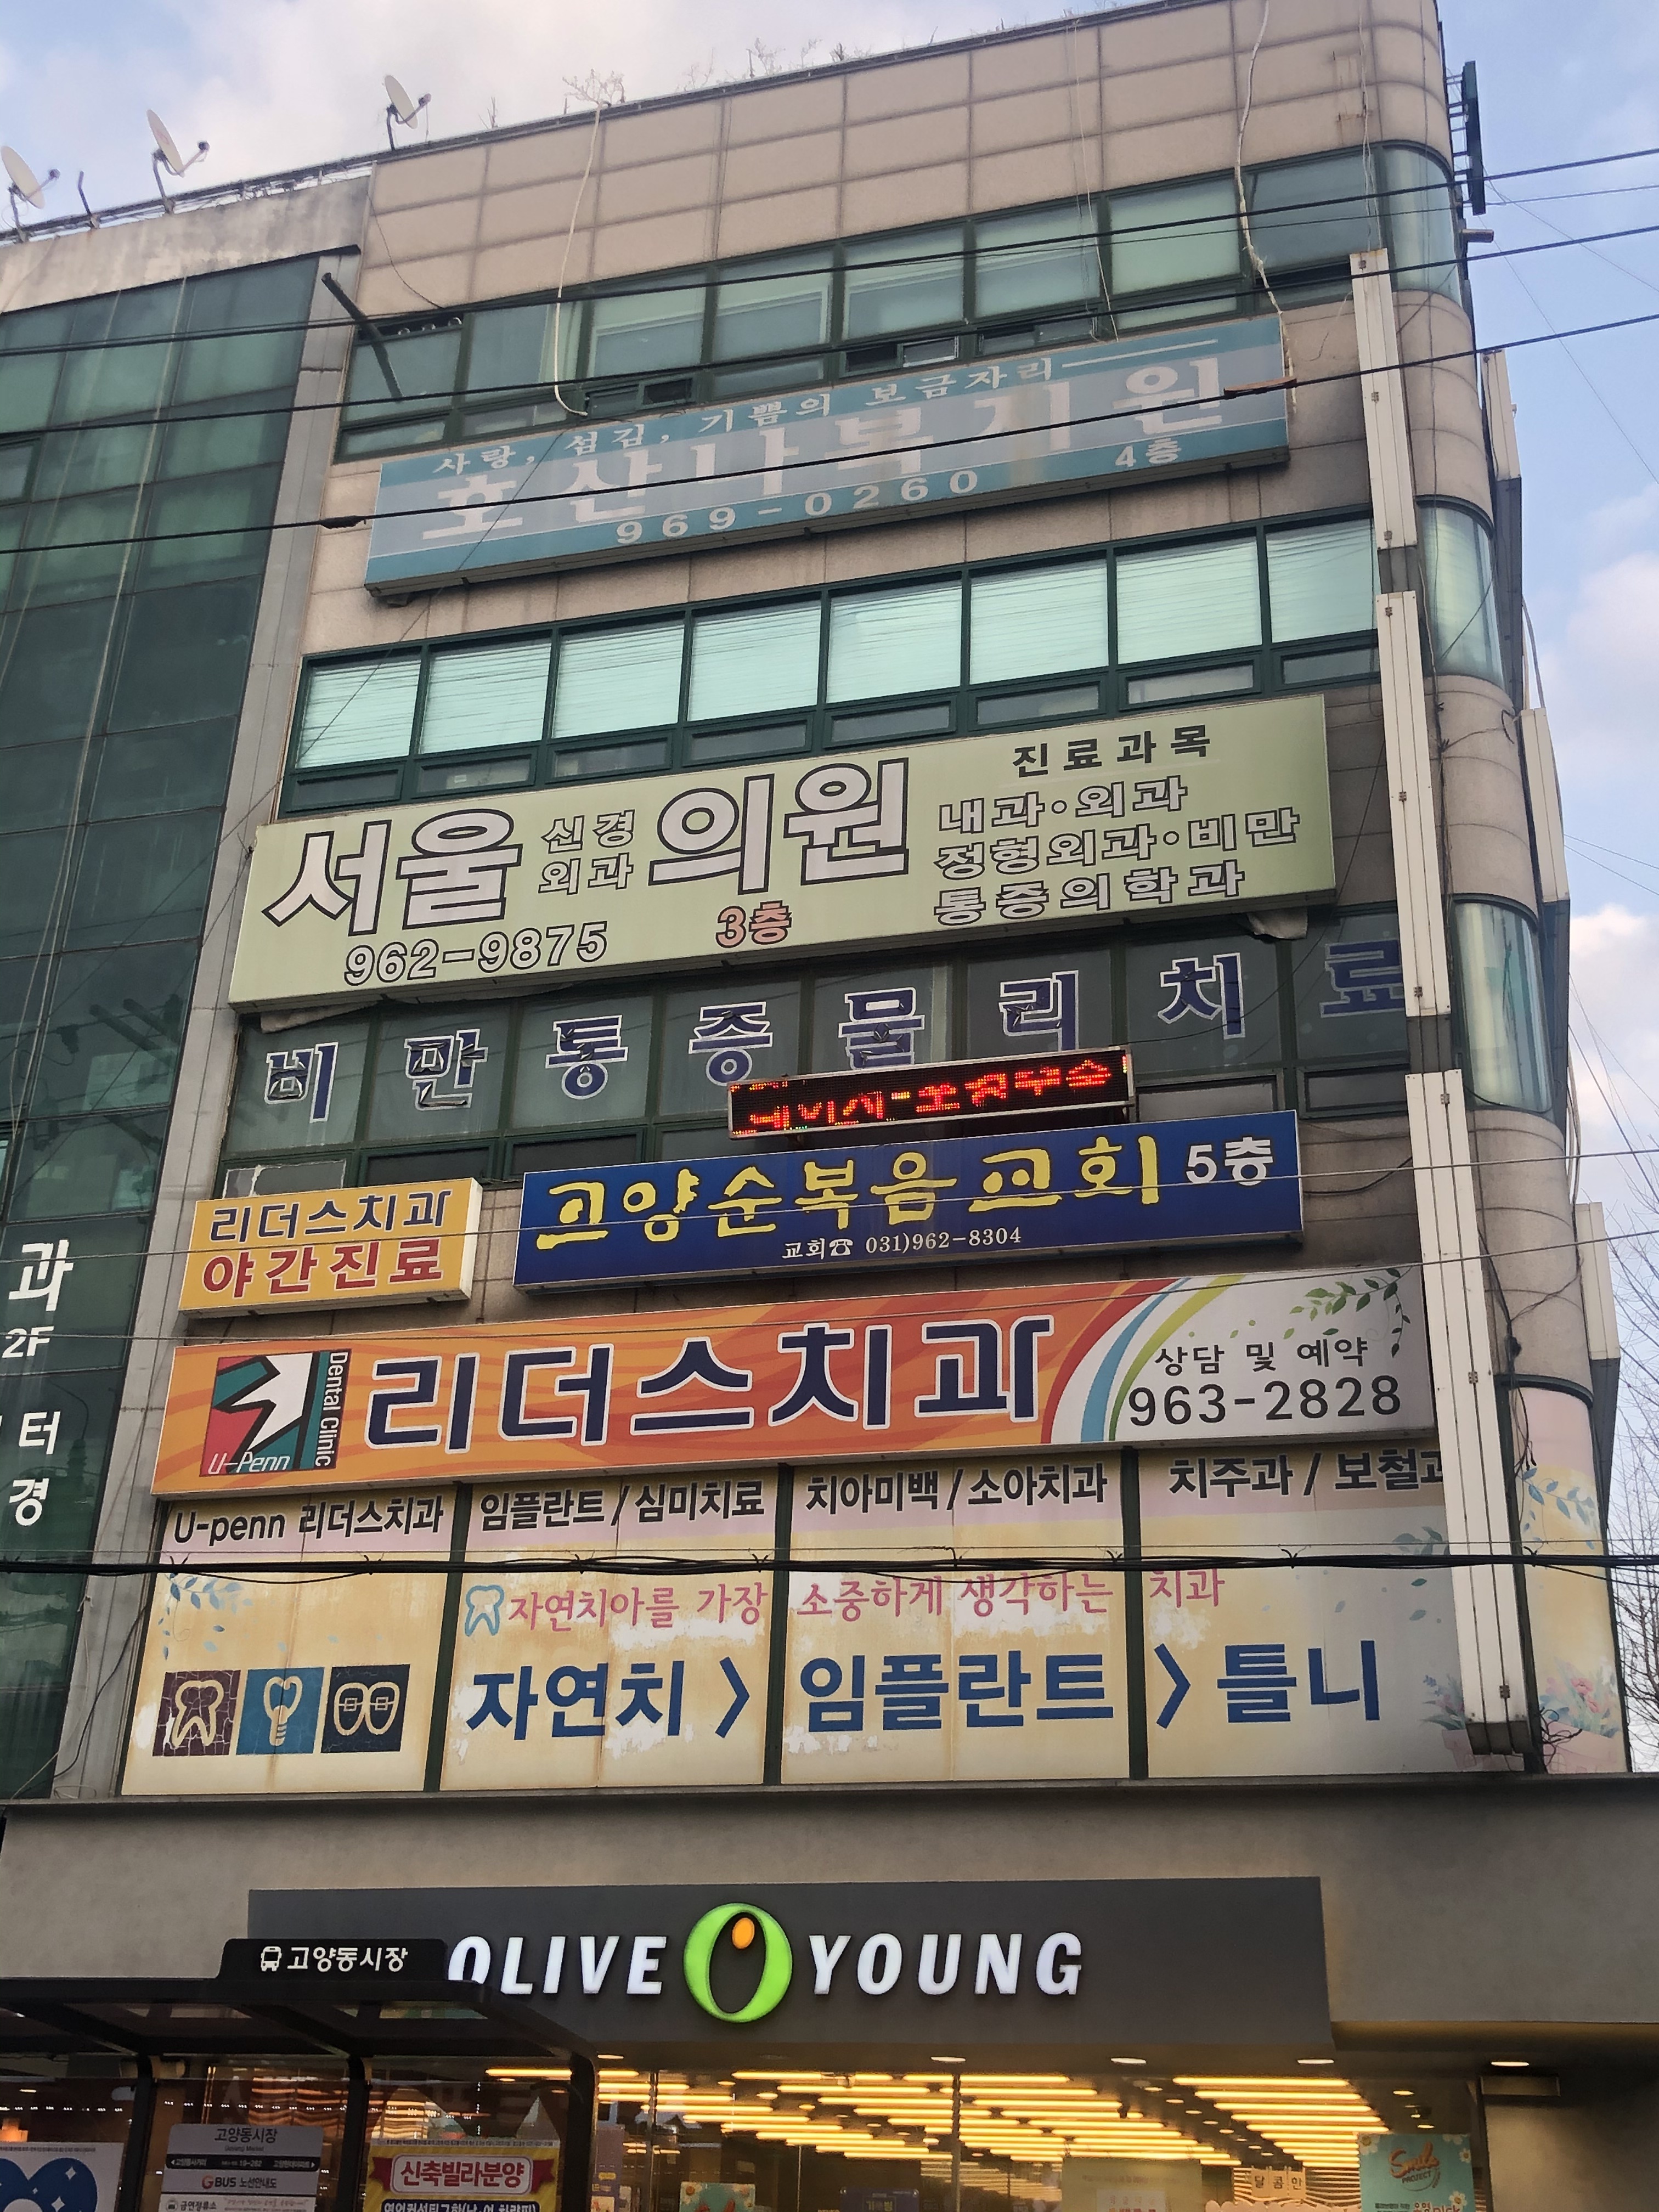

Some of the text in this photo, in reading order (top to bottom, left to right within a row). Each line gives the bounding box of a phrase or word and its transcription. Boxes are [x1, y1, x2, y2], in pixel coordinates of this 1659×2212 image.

[432, 357, 1052, 475] 사랑, 섬김, 기쁨의 보금자리
[1115, 437, 1182, 467] 4층
[617, 470, 978, 544] 969-0260
[1013, 724, 1210, 777] 진료과목
[541, 810, 635, 854] 신경
[648, 758, 909, 895] 의원
[262, 809, 523, 936] 서울
[539, 853, 634, 895] 외과
[934, 860, 1245, 926] 통증의학과
[716, 900, 792, 948] 3층
[344, 921, 608, 986] 962-9875
[1186, 1136, 1274, 1186] 5층
[210, 1190, 452, 1243] 리더스치과
[865, 1226, 1022, 1255] 031)962-8304
[9, 1239, 73, 1311] 과
[203, 1238, 442, 1298] 야간진료
[2, 1326, 54, 1358] 2F
[1154, 1336, 1369, 1376] 상담 및 예약
[314, 1351, 348, 1467] Dental Clinic
[365, 1314, 1054, 1454] 리더스치과
[1128, 1375, 1401, 1426] 963-2828
[0, 1411, 60, 1454] 터
[208, 1452, 291, 1475] U-Penn
[9, 1478, 49, 1526] 경
[174, 1496, 444, 1547] U-penn 리더스치과
[508, 1568, 1226, 1632] 자연치아를 가장 소중하게 생각하는 치과
[466, 1640, 1380, 1740] 자연치 임플란트 틀니
[287, 1946, 408, 1973] 고양동시장
[447, 1936, 667, 1995] OLIVE
[809, 1932, 1082, 1995] YOUNG
[215, 2128, 278, 2143] 고양동시장
[400, 2160, 524, 2188] 신축빌라분양
